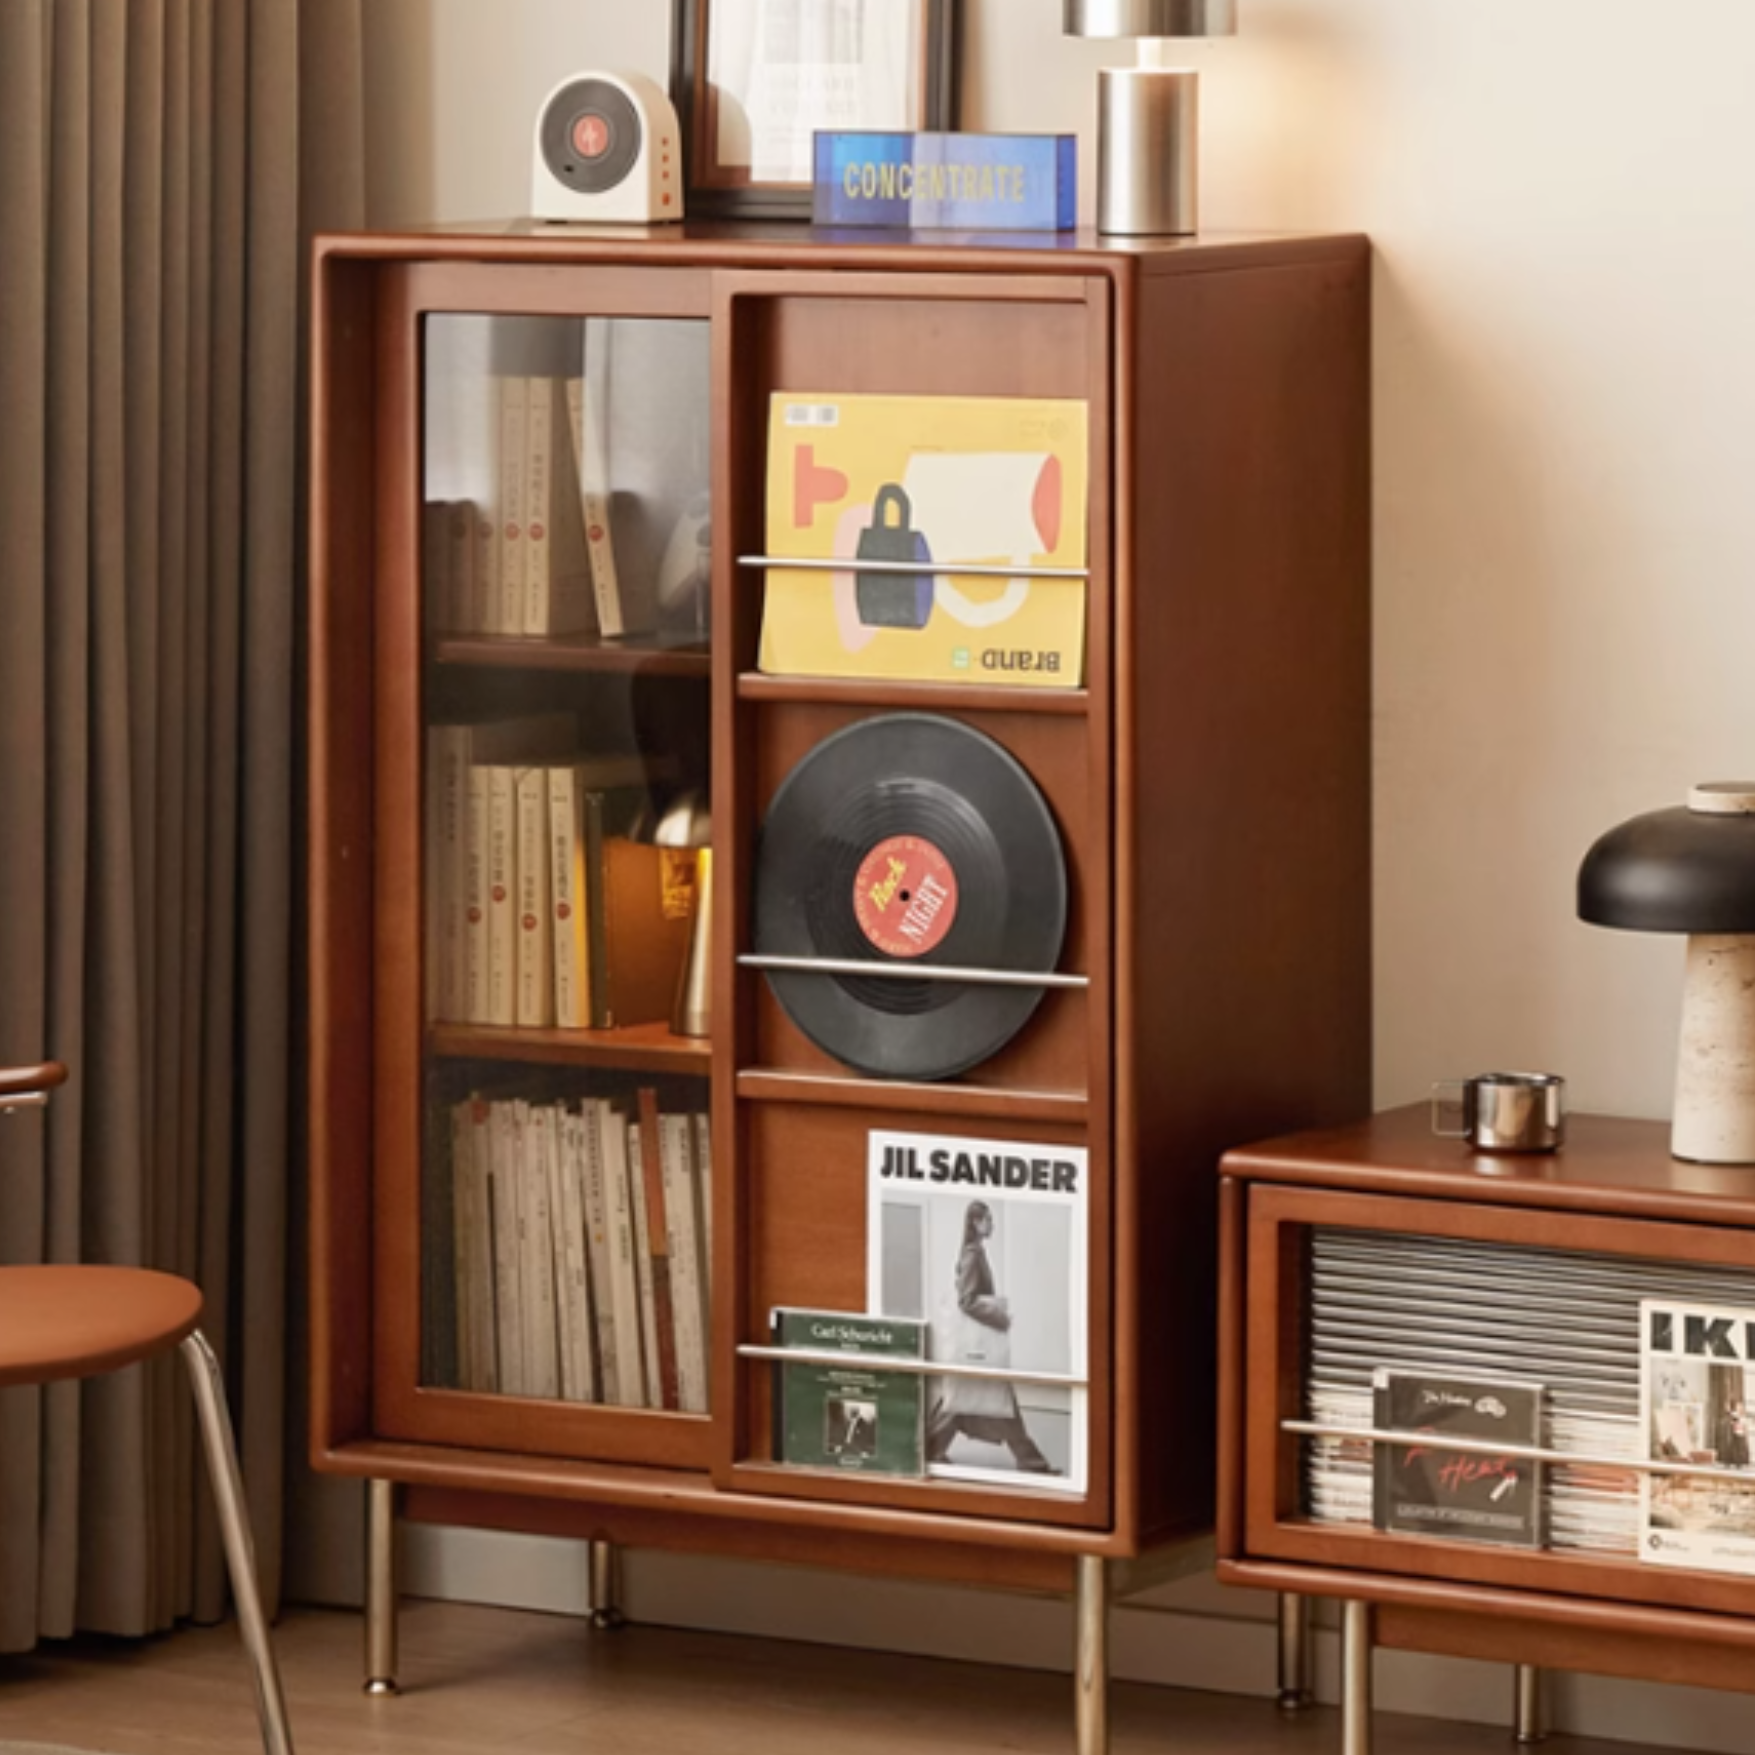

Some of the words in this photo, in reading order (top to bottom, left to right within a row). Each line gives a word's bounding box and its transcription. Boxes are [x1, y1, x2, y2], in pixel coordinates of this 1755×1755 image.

[844, 163, 1024, 201] CONCENTRATE
[898, 873, 949, 945] NIGHT
[881, 1146, 924, 1178] JIL
[929, 1149, 1078, 1193] SANDER
